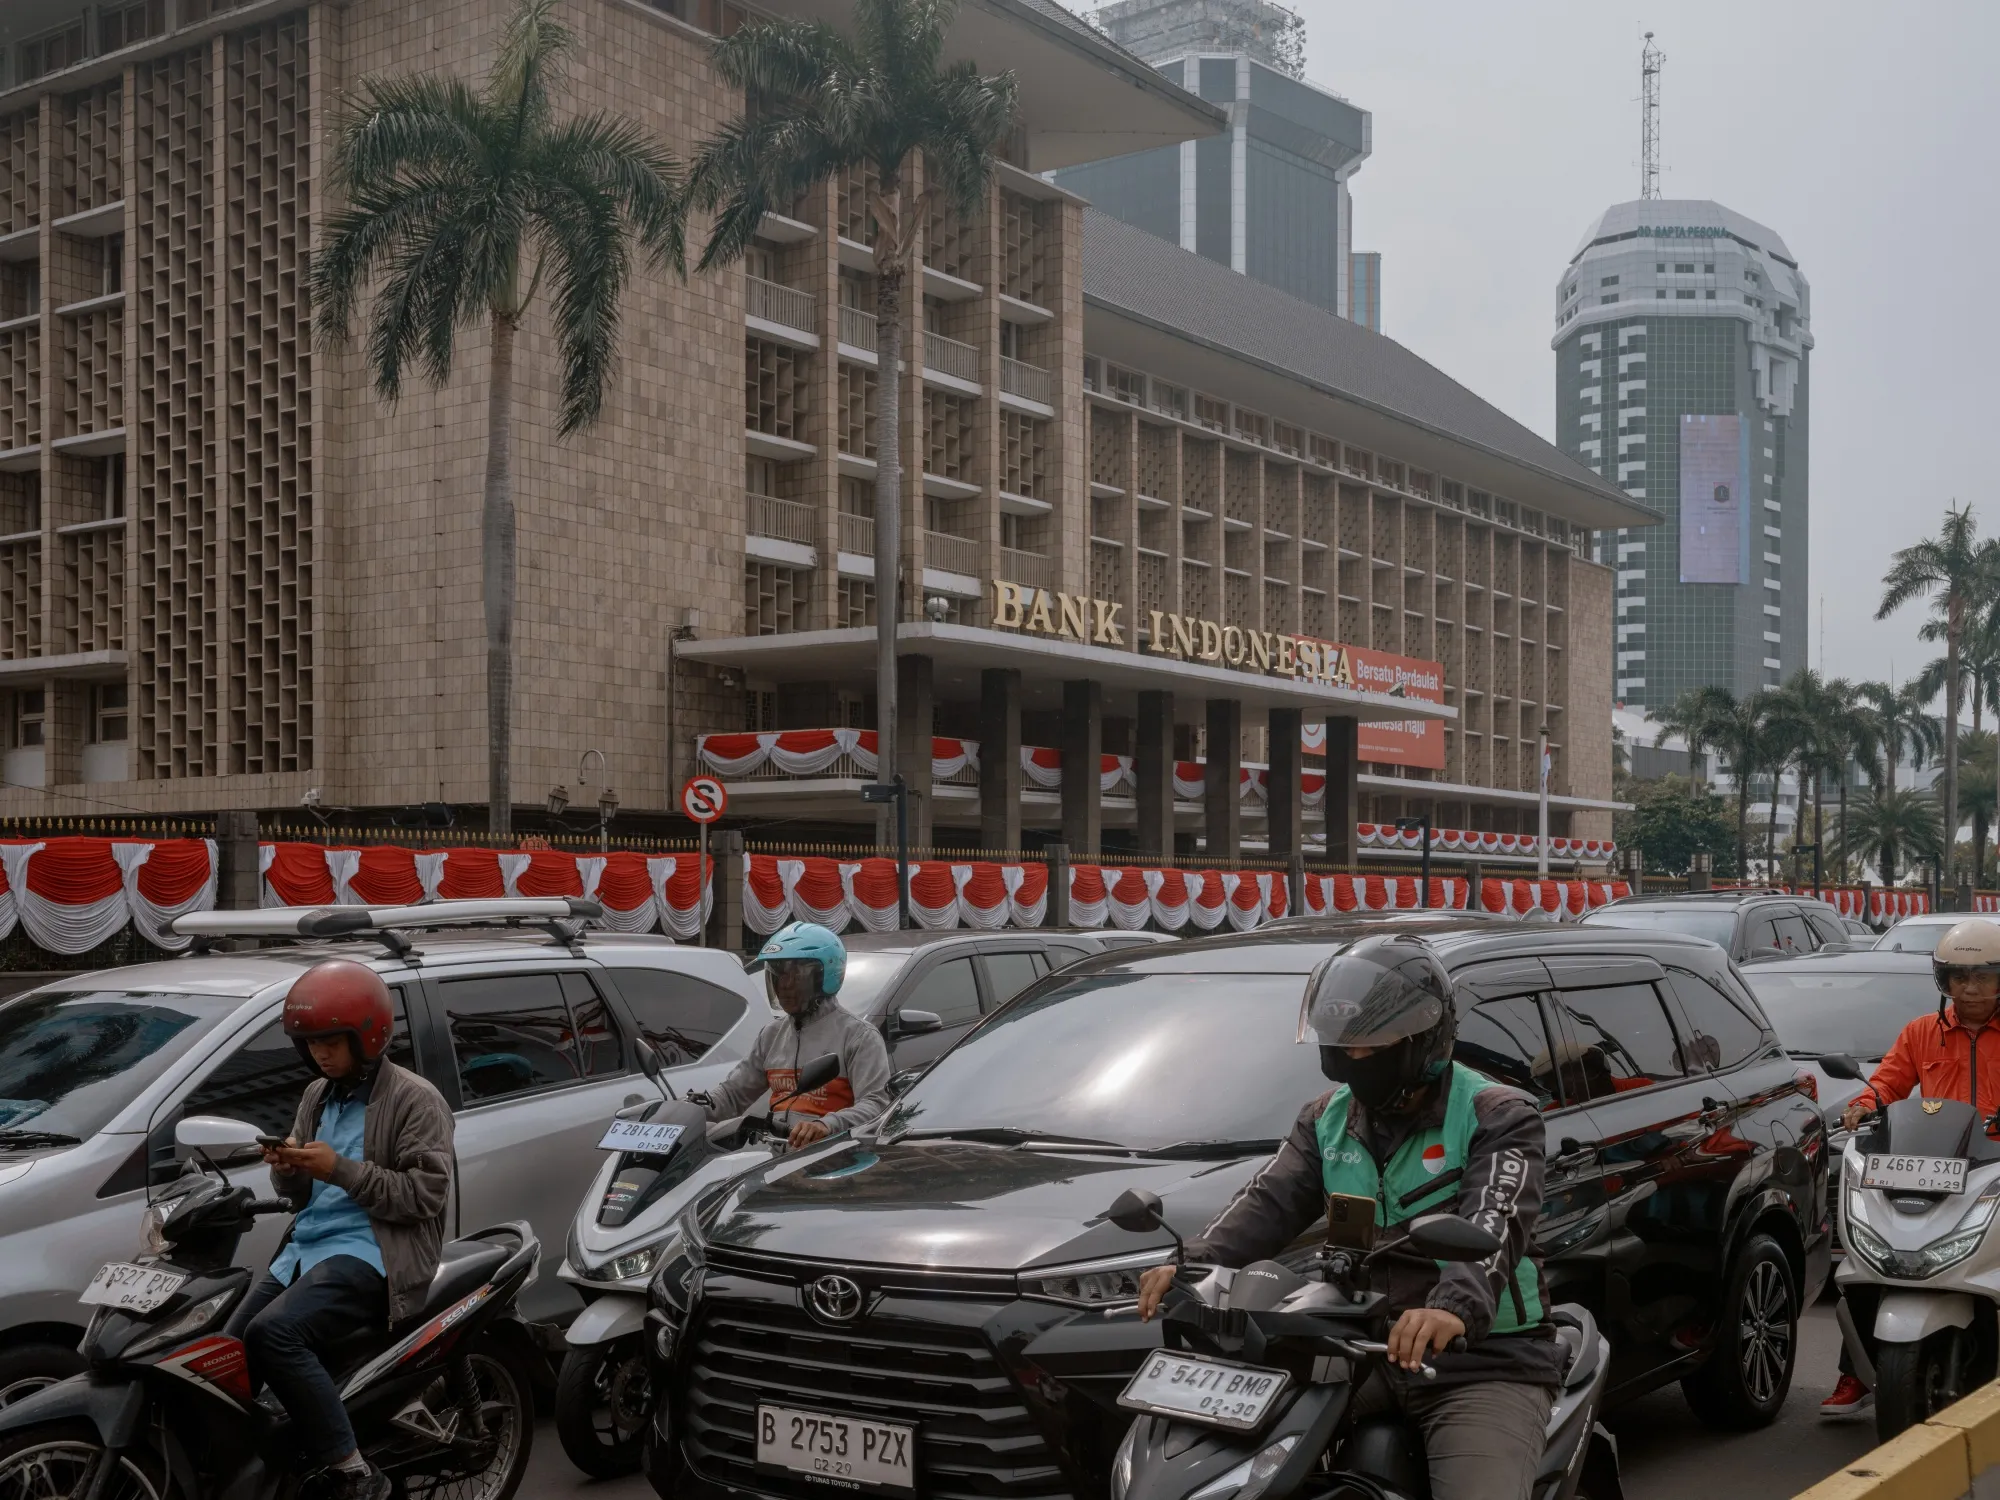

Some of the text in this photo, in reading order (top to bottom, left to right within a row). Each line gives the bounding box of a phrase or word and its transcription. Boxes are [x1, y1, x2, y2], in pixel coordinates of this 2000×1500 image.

[1687, 226, 1727, 239] PESONA
[993, 579, 1354, 684] BANK INDONESIA
[1357, 659, 1394, 684] Bersatu
[1396, 666, 1439, 691] Berdaulat
[611, 1122, 621, 1134] G
[622, 1124, 653, 1137] 2814
[1324, 1146, 1362, 1164] Grab
[1871, 1158, 1963, 1175] B 4667 SXD
[94, 1266, 108, 1283] B
[147, 1273, 181, 1293] PXU
[1247, 1270, 1279, 1280] HONDA
[441, 1295, 478, 1328] REVO
[203, 1350, 242, 1368] HONDA
[1148, 1359, 1167, 1379] B
[1171, 1364, 1225, 1391] 5471
[762, 1412, 907, 1468] B 2753 PZX
[812, 1475, 852, 1489] TUNAS TOYOTA
